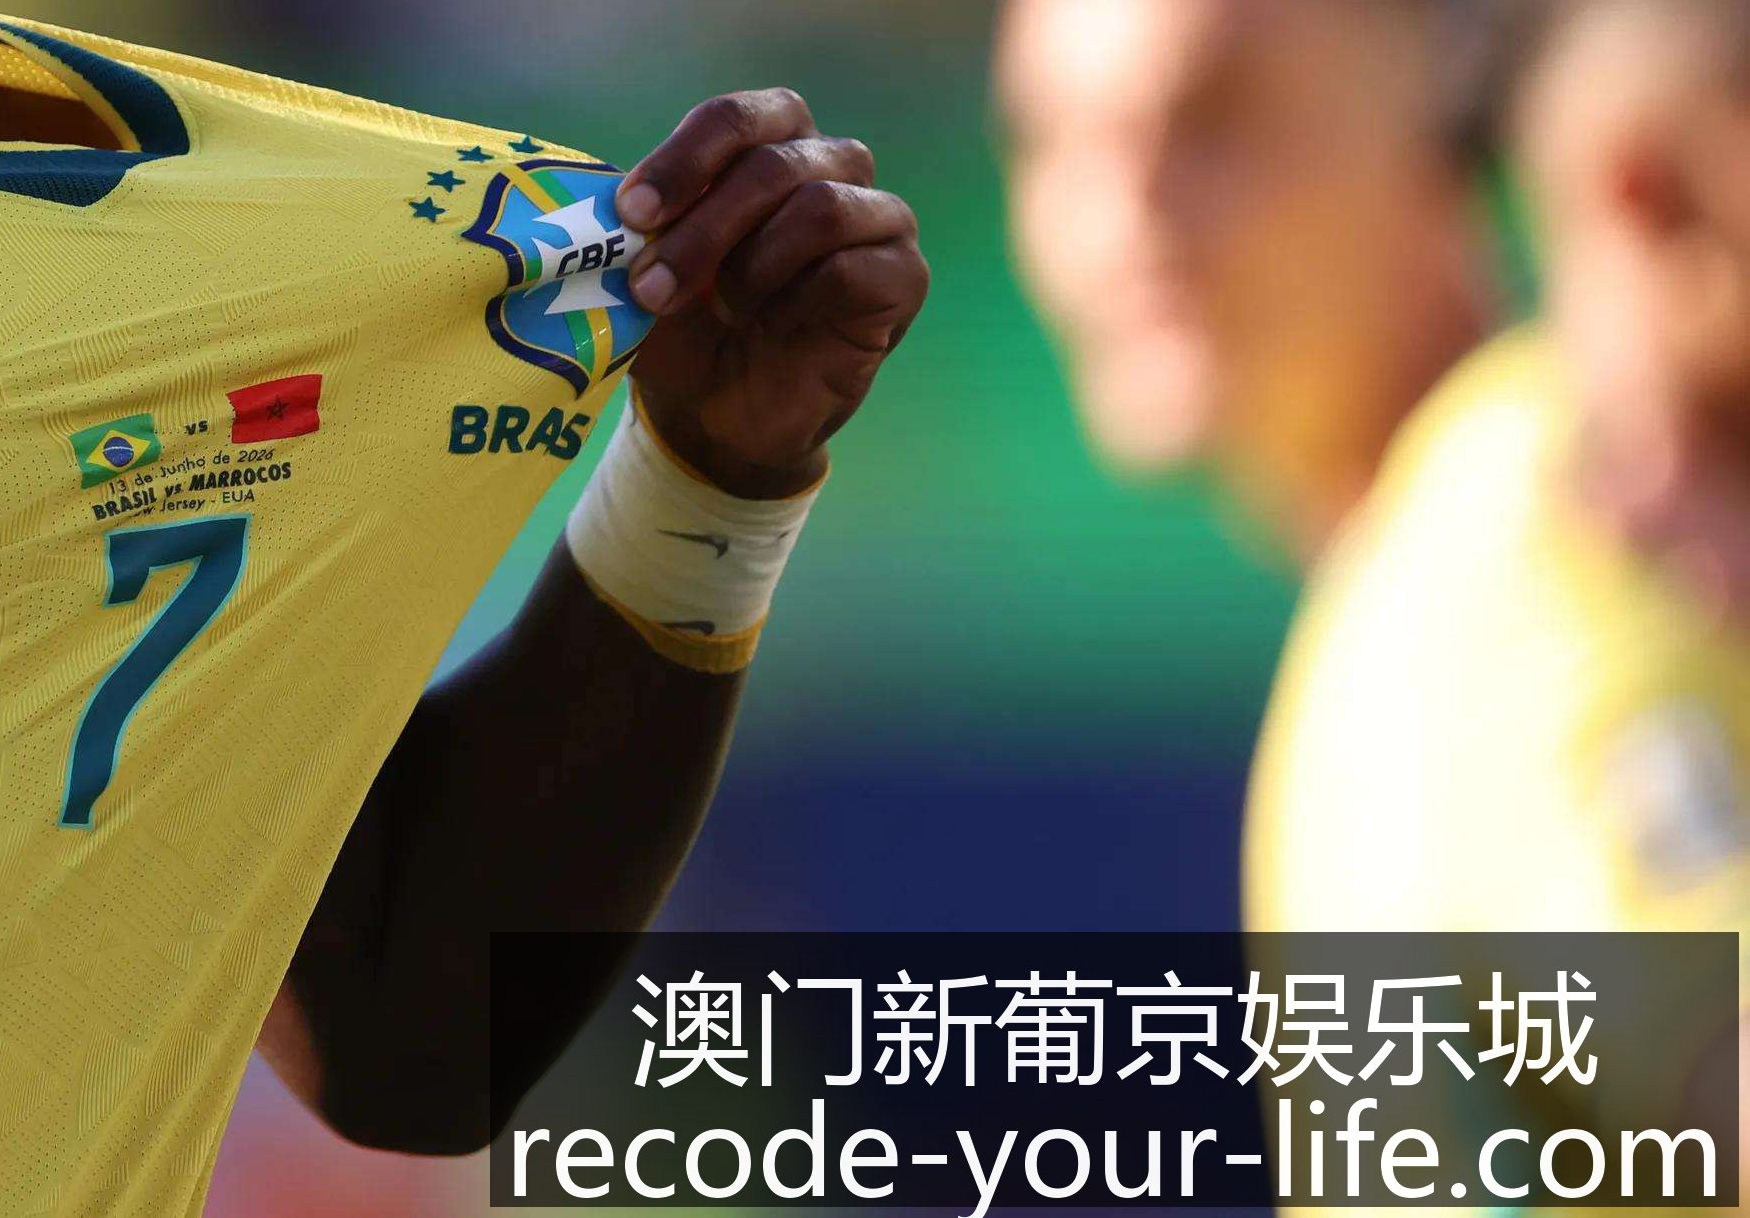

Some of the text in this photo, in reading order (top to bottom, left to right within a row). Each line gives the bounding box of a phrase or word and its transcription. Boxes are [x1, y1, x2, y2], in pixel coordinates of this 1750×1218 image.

[555, 234, 625, 278] CBF
[185, 420, 208, 435] vs
[92, 487, 157, 520] BRASIL
[165, 483, 182, 498] vs
[189, 462, 291, 491] MARROCOS
[109, 479, 127, 494] 13
[134, 473, 153, 486] de
[213, 450, 230, 464] de
[237, 448, 275, 463] 2026
[222, 489, 255, 503] EUA
[58, 513, 251, 830] 7
